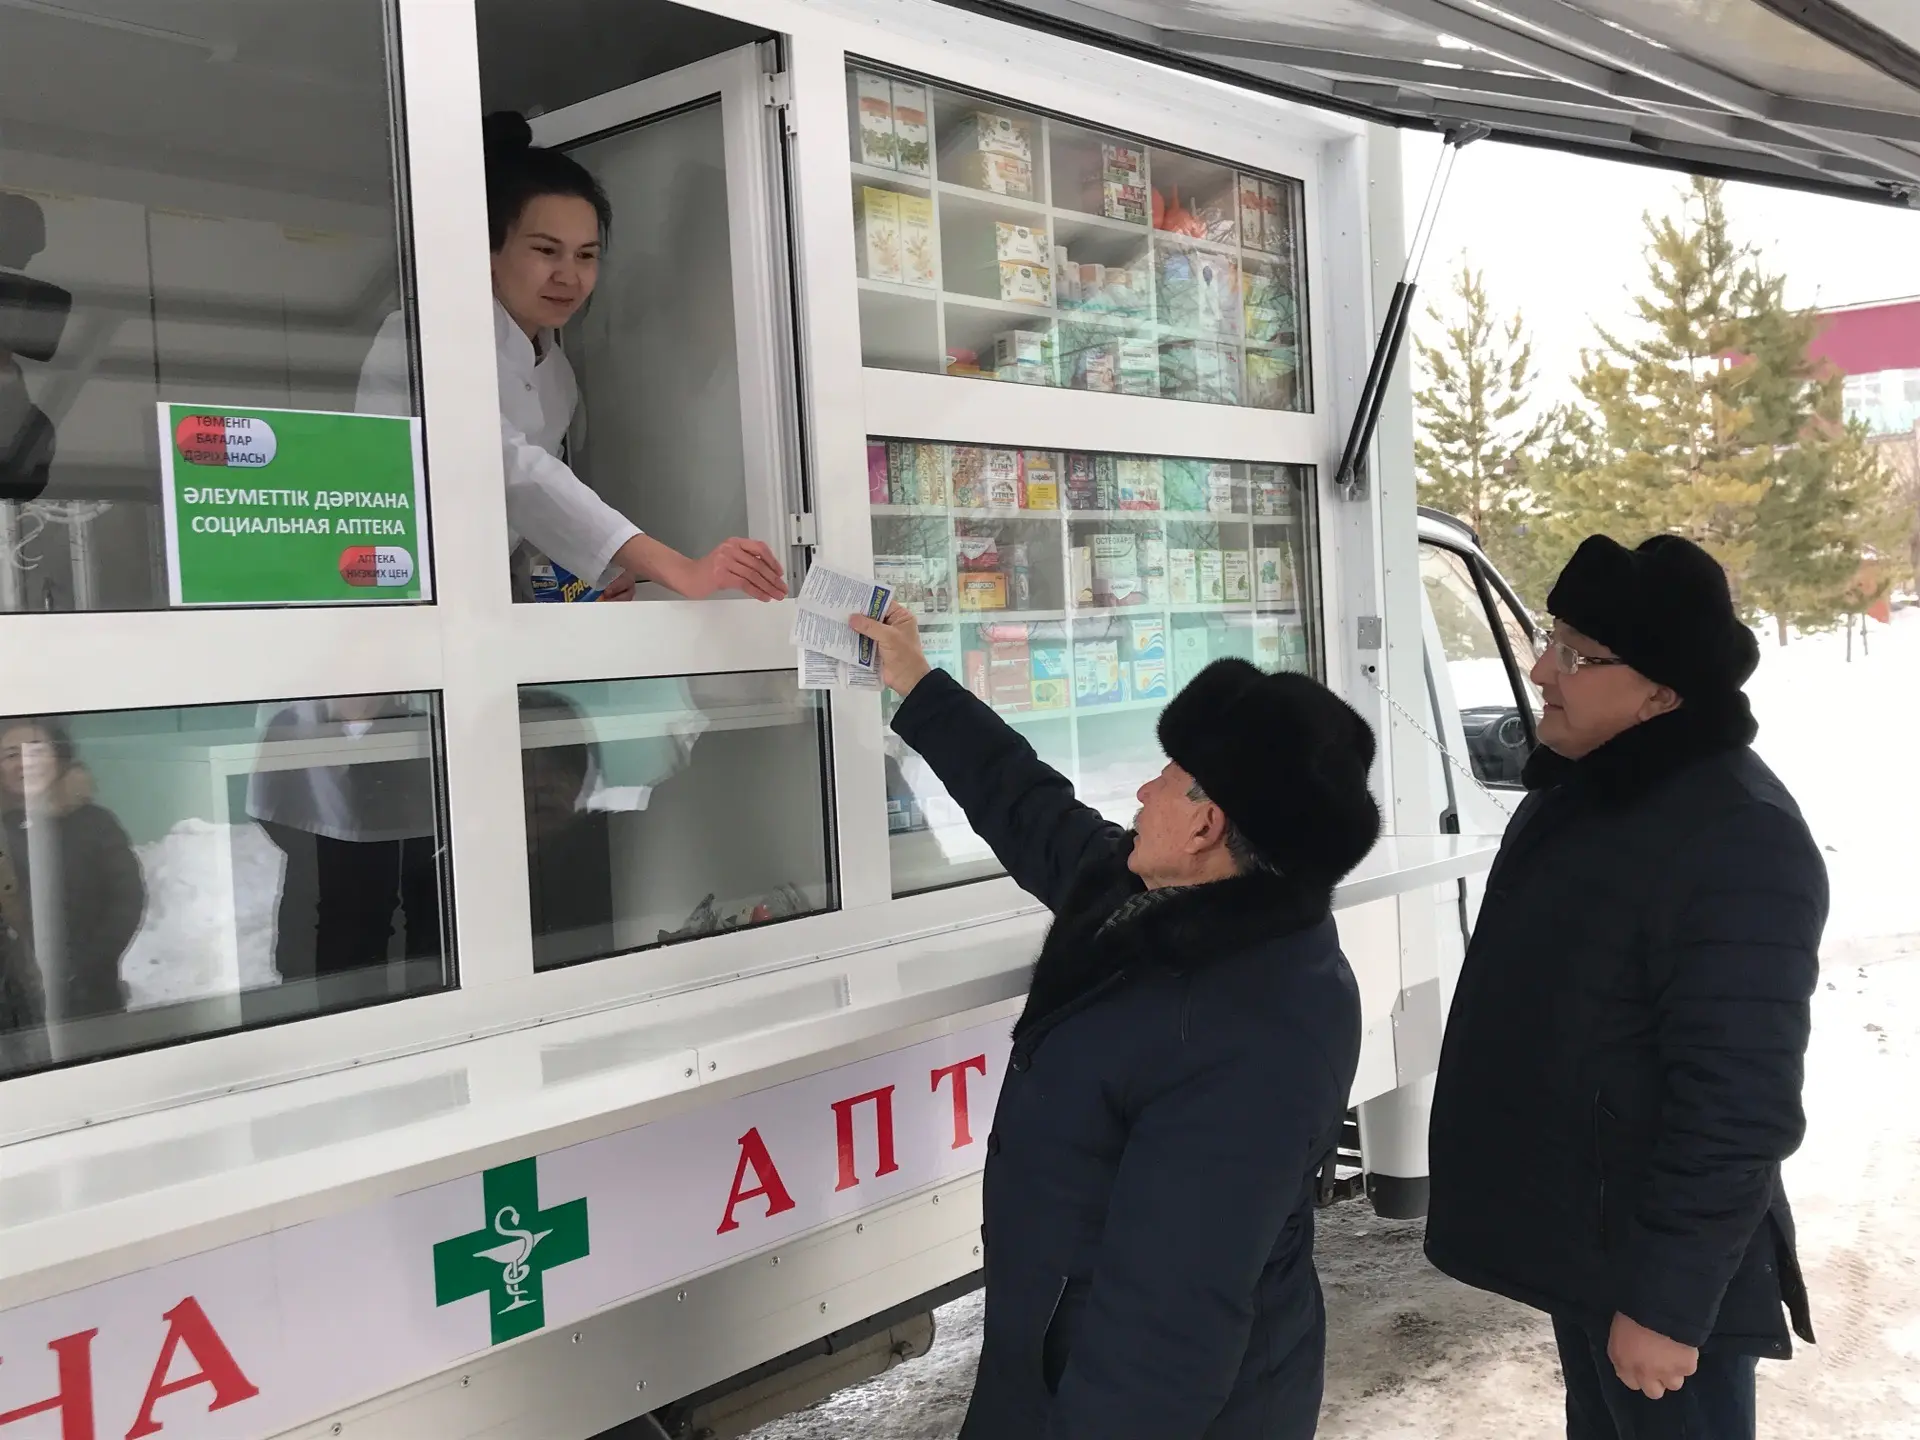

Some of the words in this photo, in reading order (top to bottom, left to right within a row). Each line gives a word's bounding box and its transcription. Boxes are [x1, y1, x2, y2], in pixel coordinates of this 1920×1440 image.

[195, 415, 251, 429] ТӨМЕНГІ
[196, 432, 252, 446] БАҒАЛАР
[184, 449, 266, 464] ДӘРІХАНАСЫ
[183, 487, 309, 507] ӘЛЕУМЕТТІК
[314, 490, 410, 511] ДӘРІХАНА
[191, 515, 330, 536] СОЦИАЛЬНАЯ
[335, 518, 406, 535] АПТЕКА
[357, 554, 396, 564] АПТЕКА
[345, 569, 387, 579] НИЗКИХ
[388, 569, 409, 580] ЦЕН
[717, 1053, 987, 1236] АПТ
[0, 1295, 260, 1440] НА
